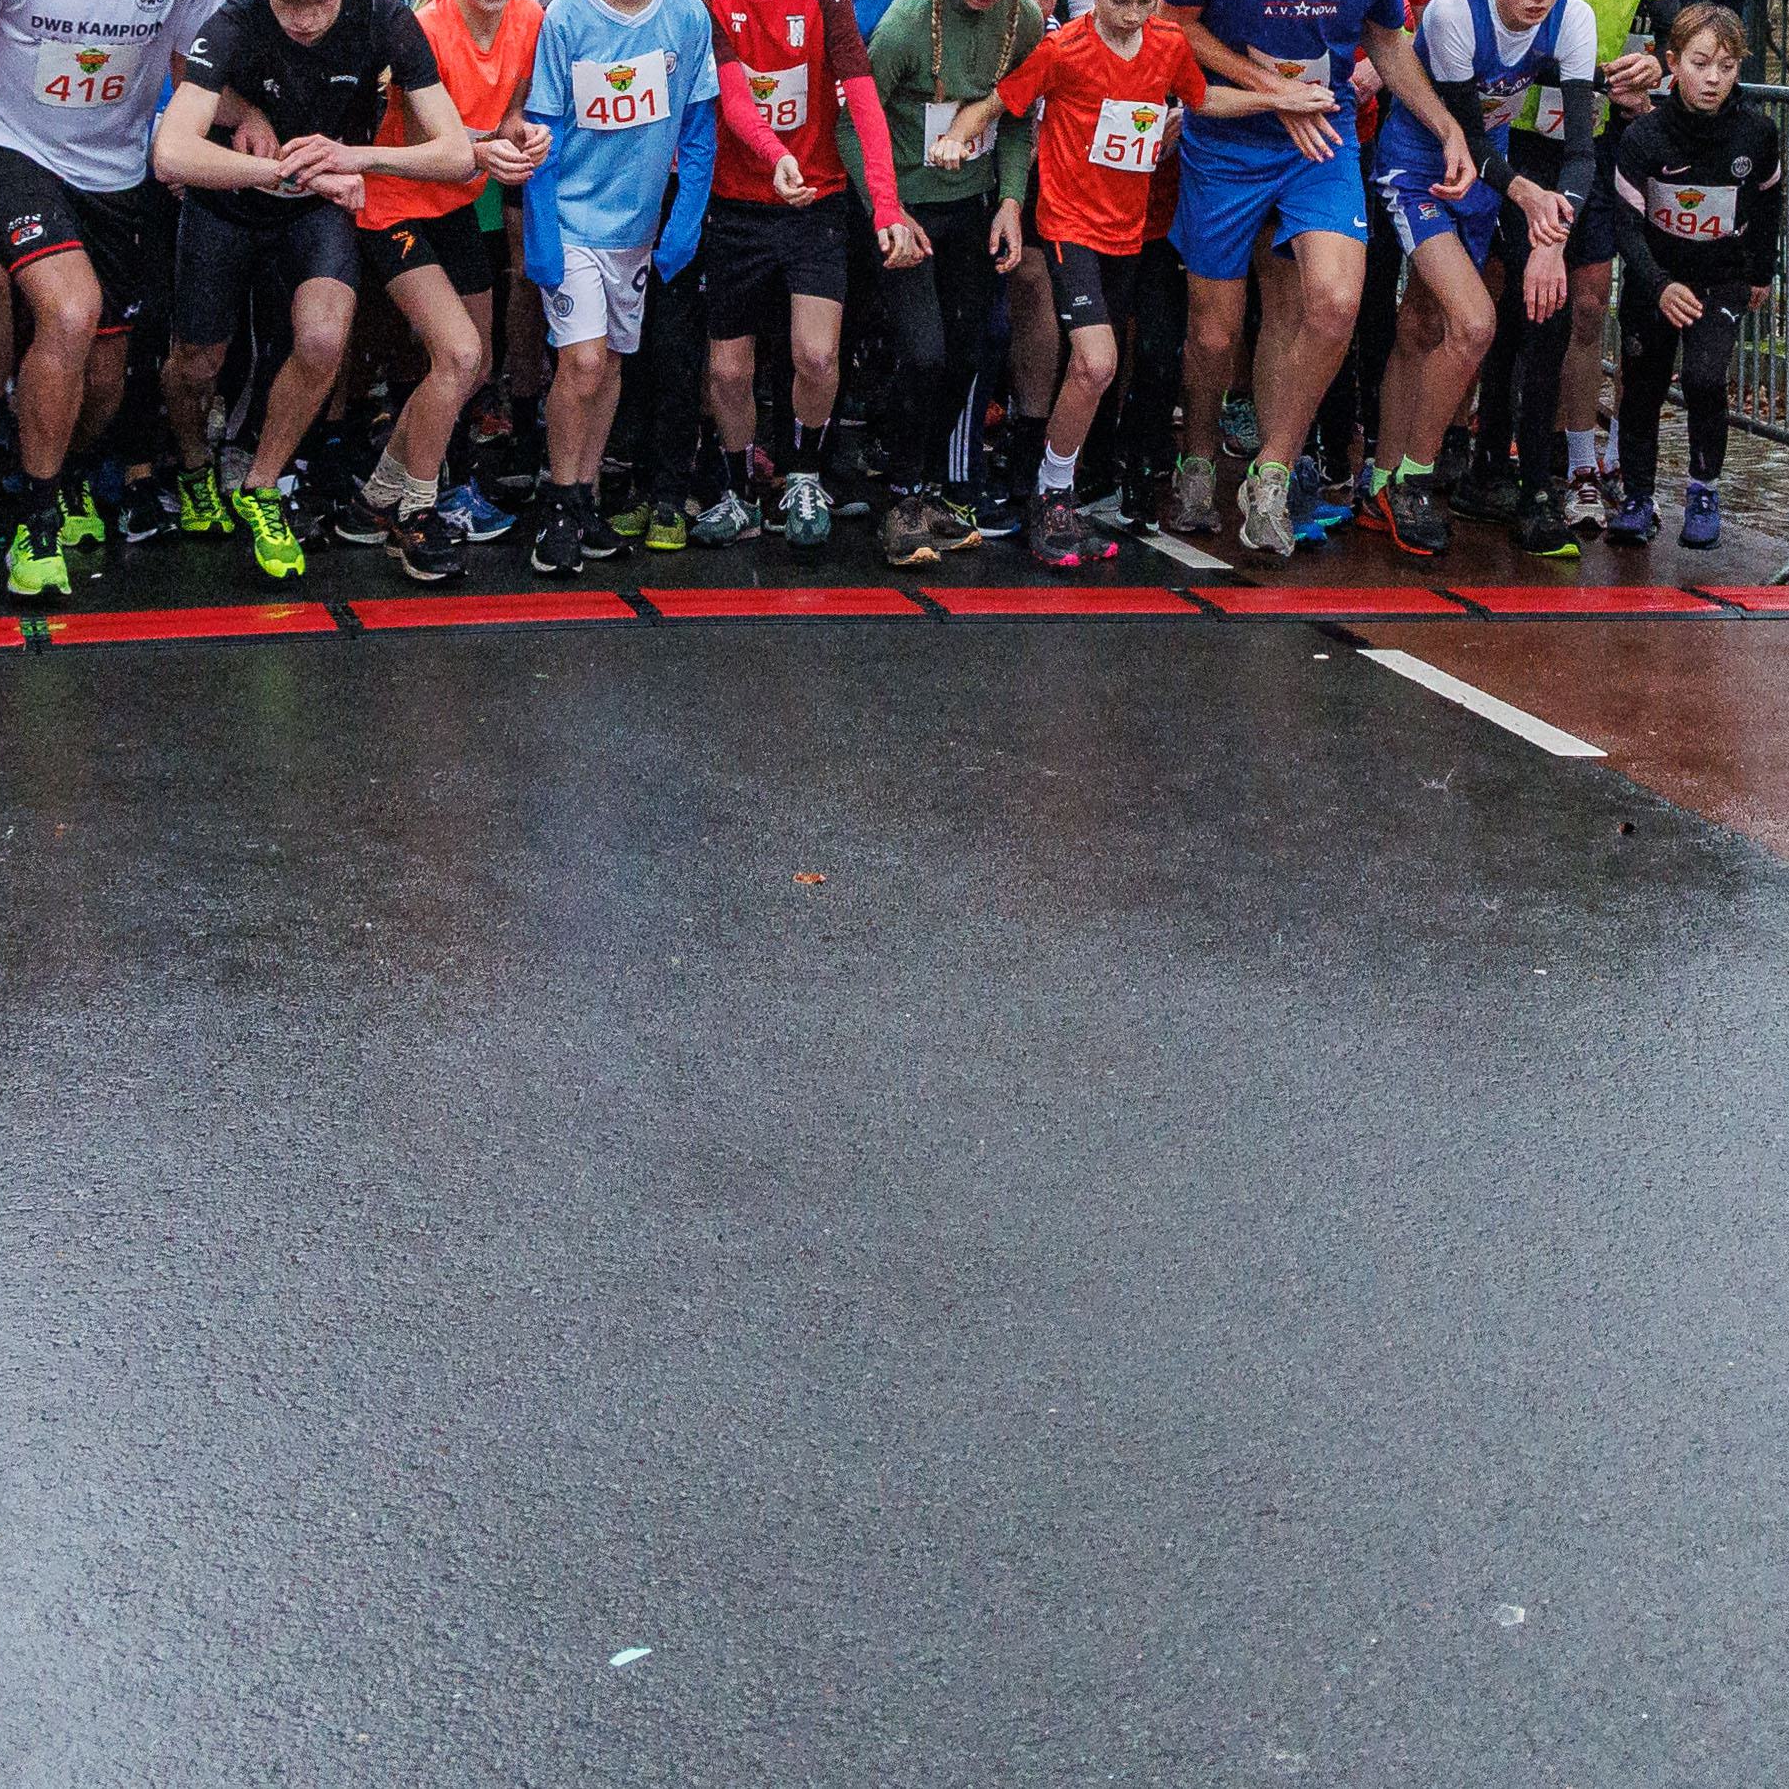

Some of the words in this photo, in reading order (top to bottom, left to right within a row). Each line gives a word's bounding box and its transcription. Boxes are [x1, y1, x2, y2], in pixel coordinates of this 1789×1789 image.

[31, 15, 74, 34] DWB
[1311, 5, 1339, 16] NOVA
[44, 74, 127, 103] 416
[585, 87, 656, 125] 401
[1653, 207, 1722, 238] 494
